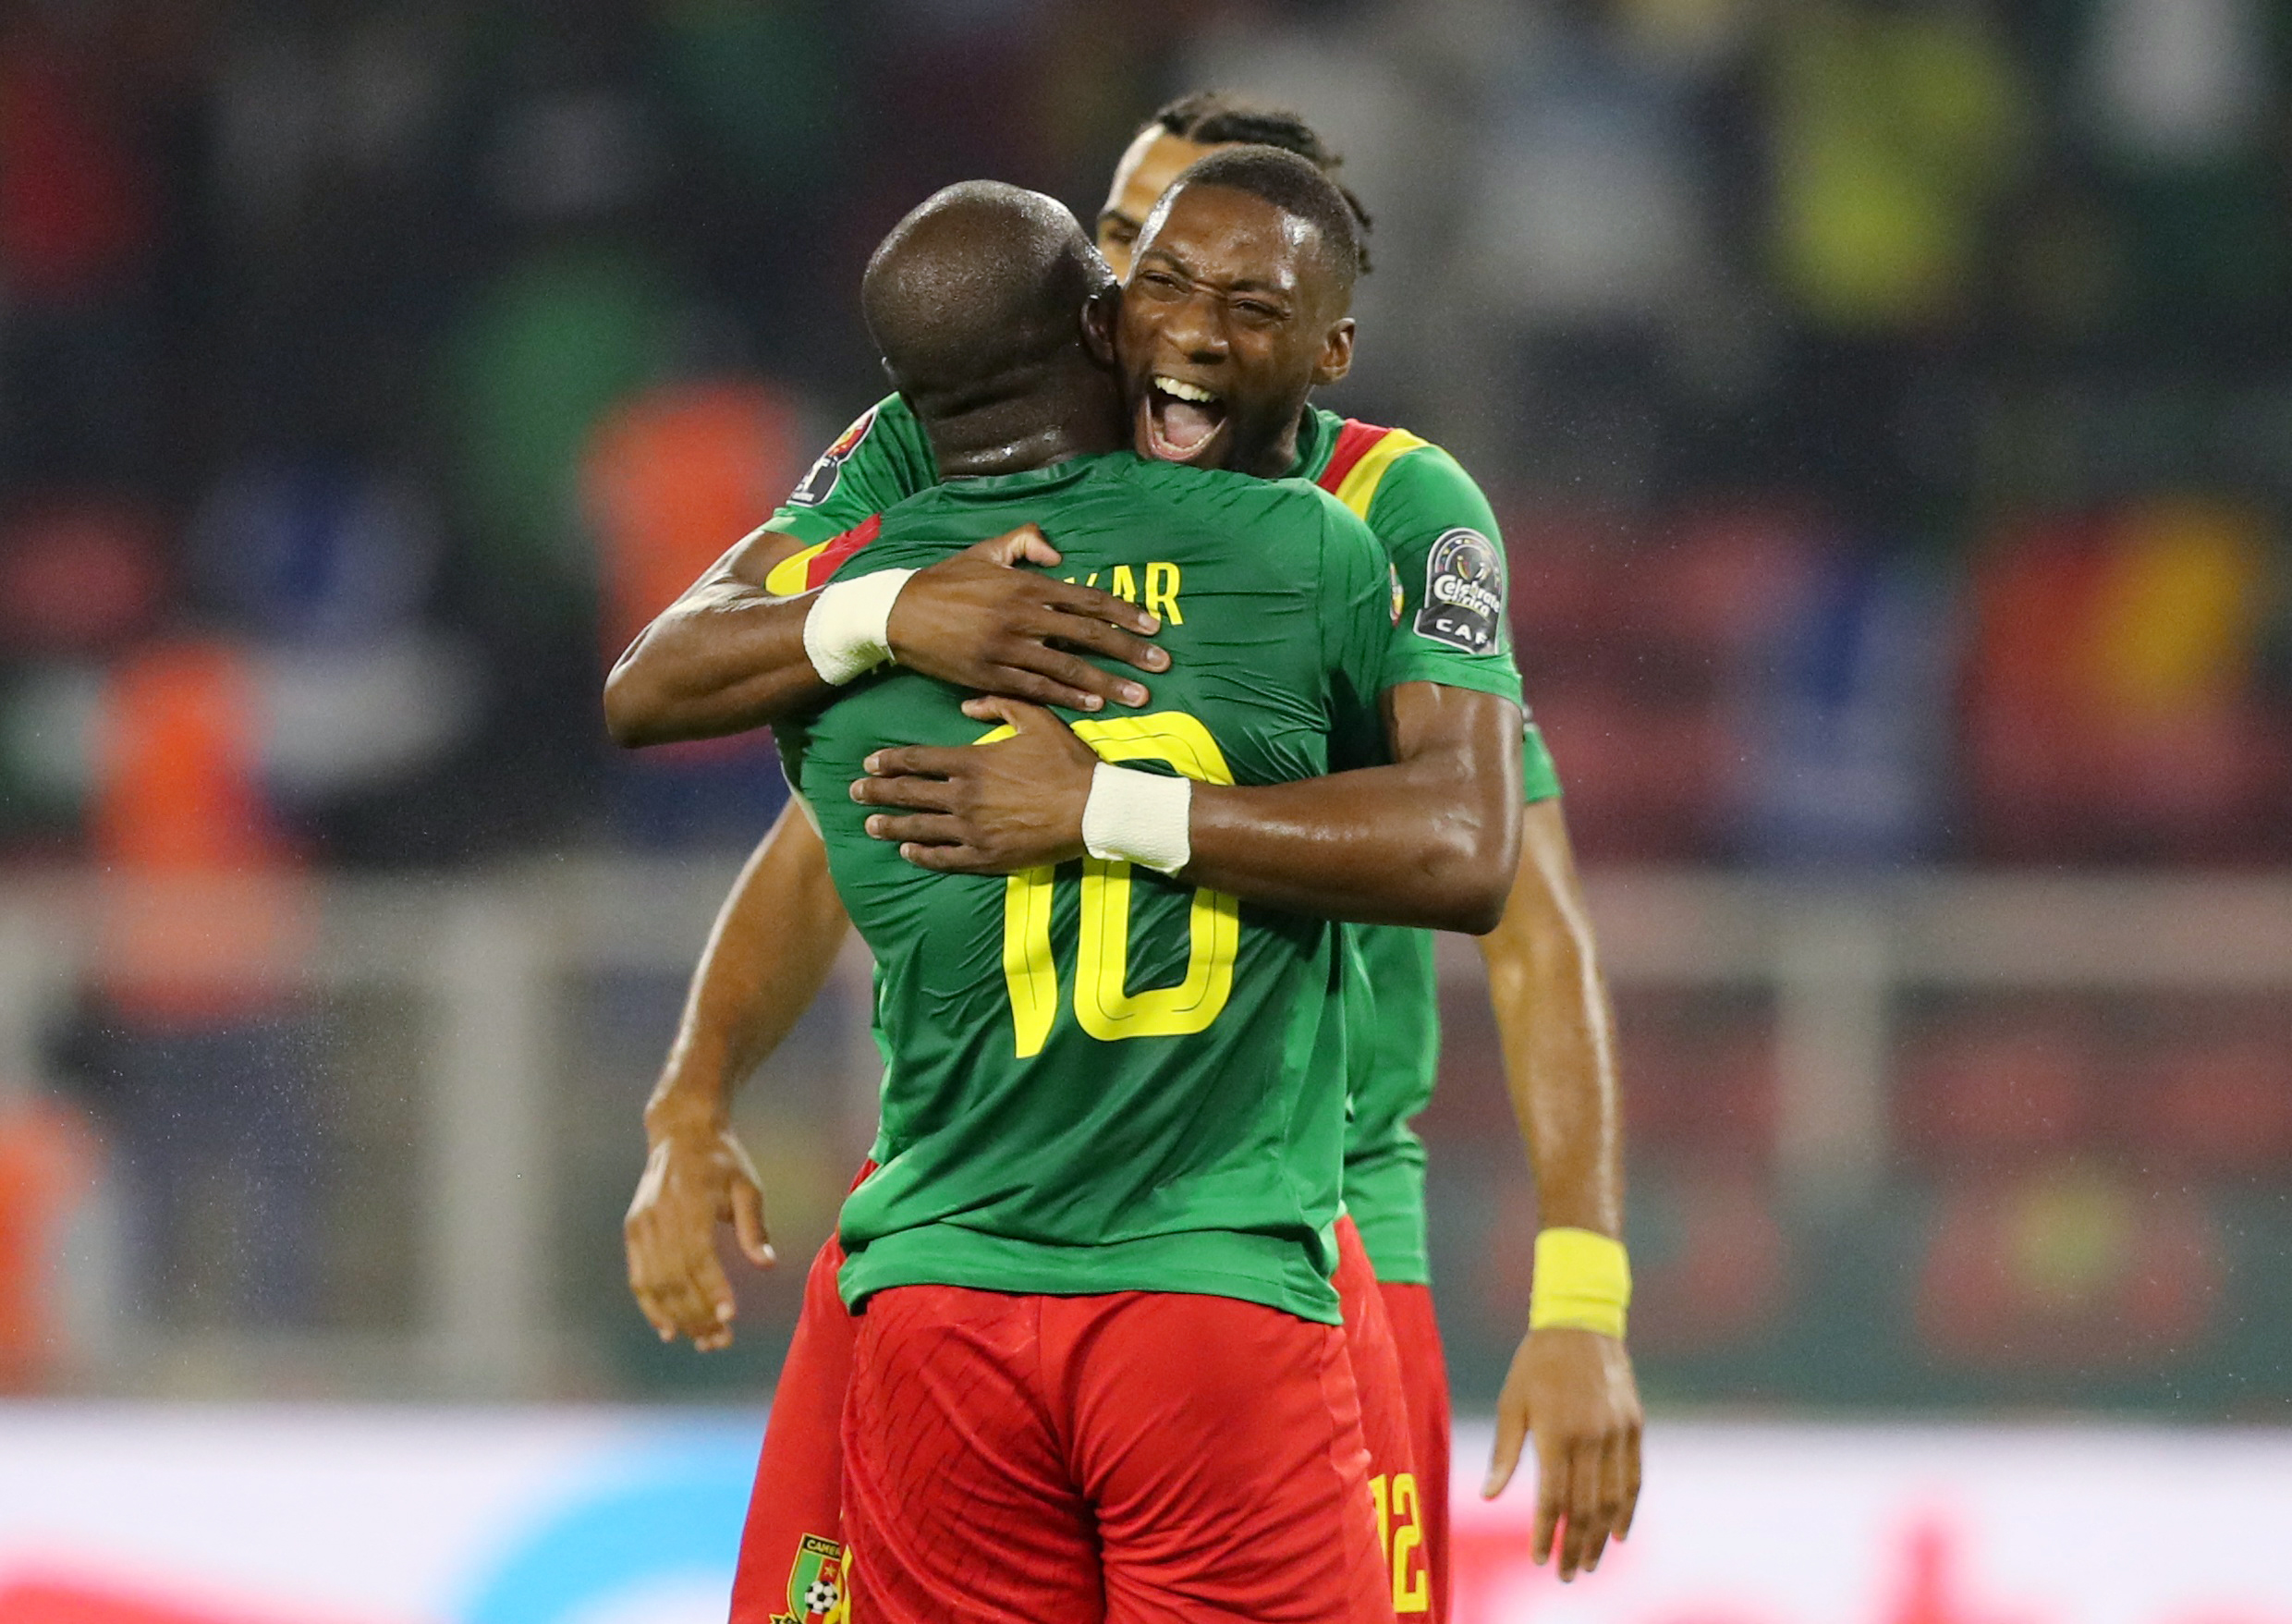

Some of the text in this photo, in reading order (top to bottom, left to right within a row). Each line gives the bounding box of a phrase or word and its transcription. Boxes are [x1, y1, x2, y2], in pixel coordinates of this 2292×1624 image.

[1064, 562, 1184, 629] AR
[1435, 618, 1488, 644] CAF
[971, 712, 1239, 1058] 10
